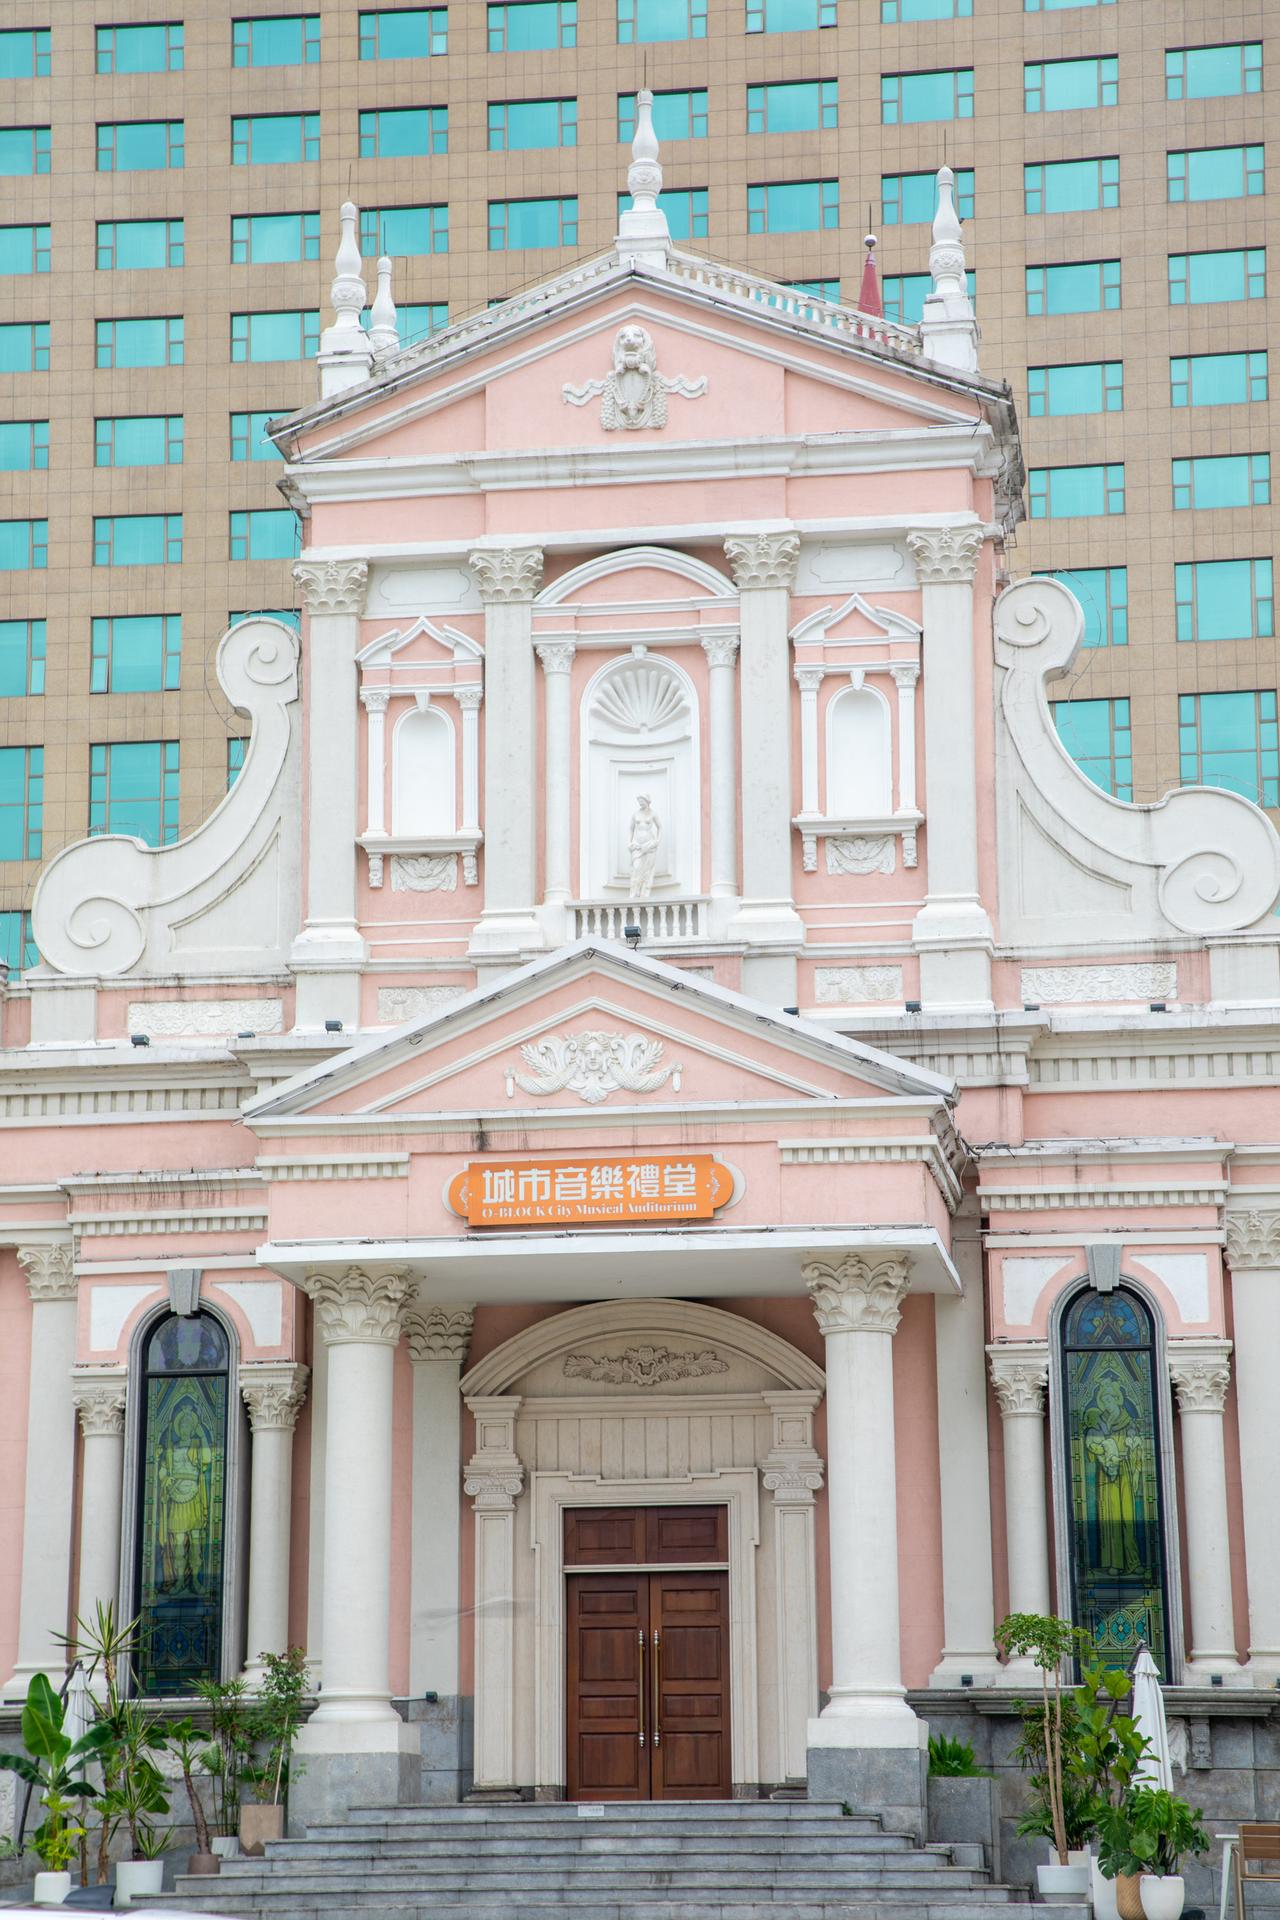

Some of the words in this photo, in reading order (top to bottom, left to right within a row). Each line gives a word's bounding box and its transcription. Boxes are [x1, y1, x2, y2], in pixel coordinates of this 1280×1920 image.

[482, 1163, 697, 1204] 城市音樂禮堂
[482, 1205, 545, 1218] O-BLOCK
[547, 1204, 571, 1218] City
[576, 1202, 623, 1215] Musical
[628, 1200, 697, 1213] Auditorium
